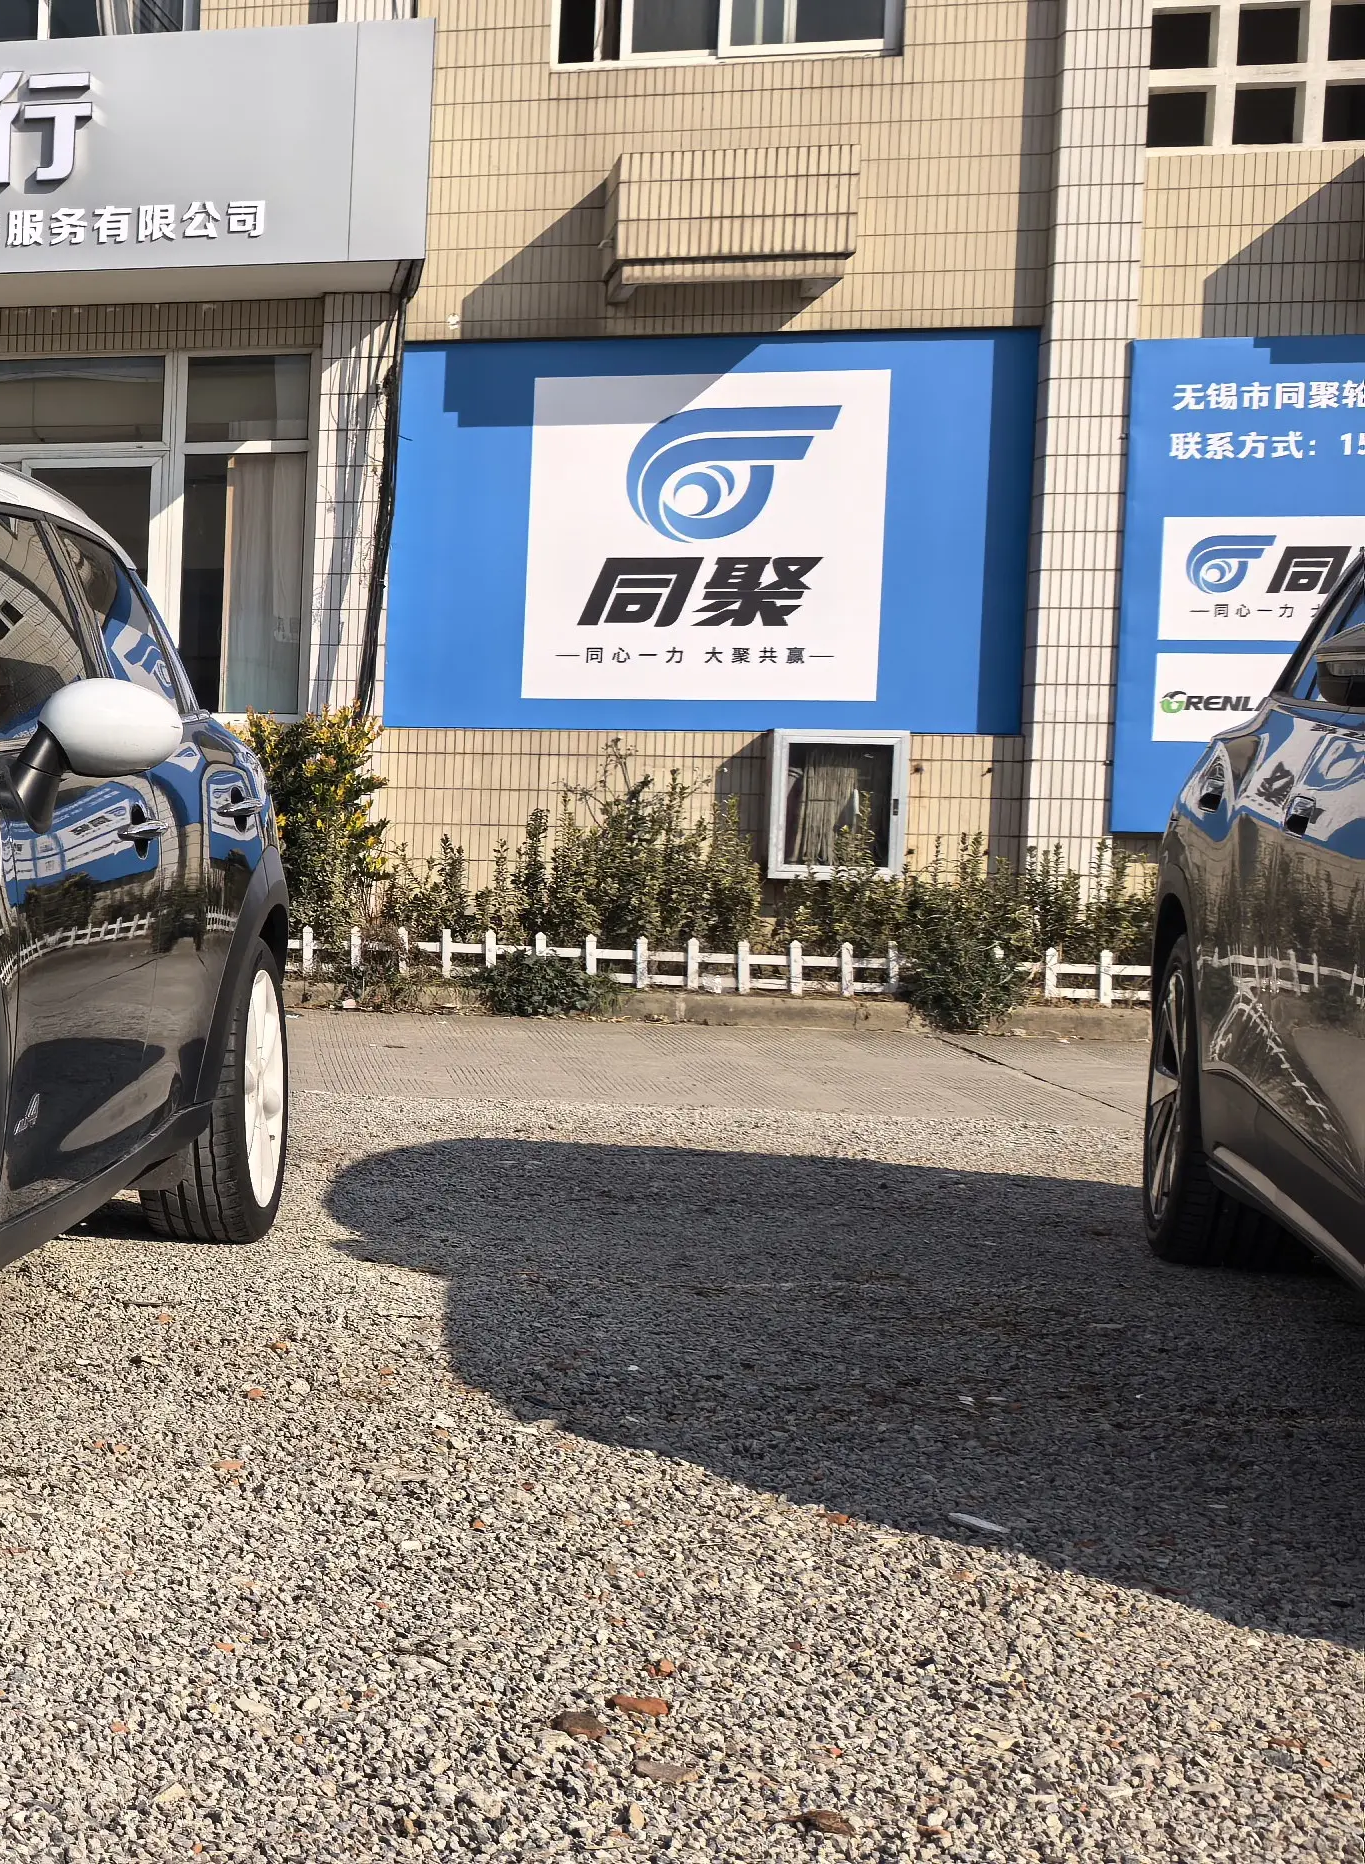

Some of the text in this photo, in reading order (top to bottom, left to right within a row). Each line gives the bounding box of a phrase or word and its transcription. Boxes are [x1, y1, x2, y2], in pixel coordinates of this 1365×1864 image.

[577, 556, 824, 627] 同聚
[1265, 546, 1365, 595] 同
[586, 646, 806, 664] 同心一力 大聚共赢
